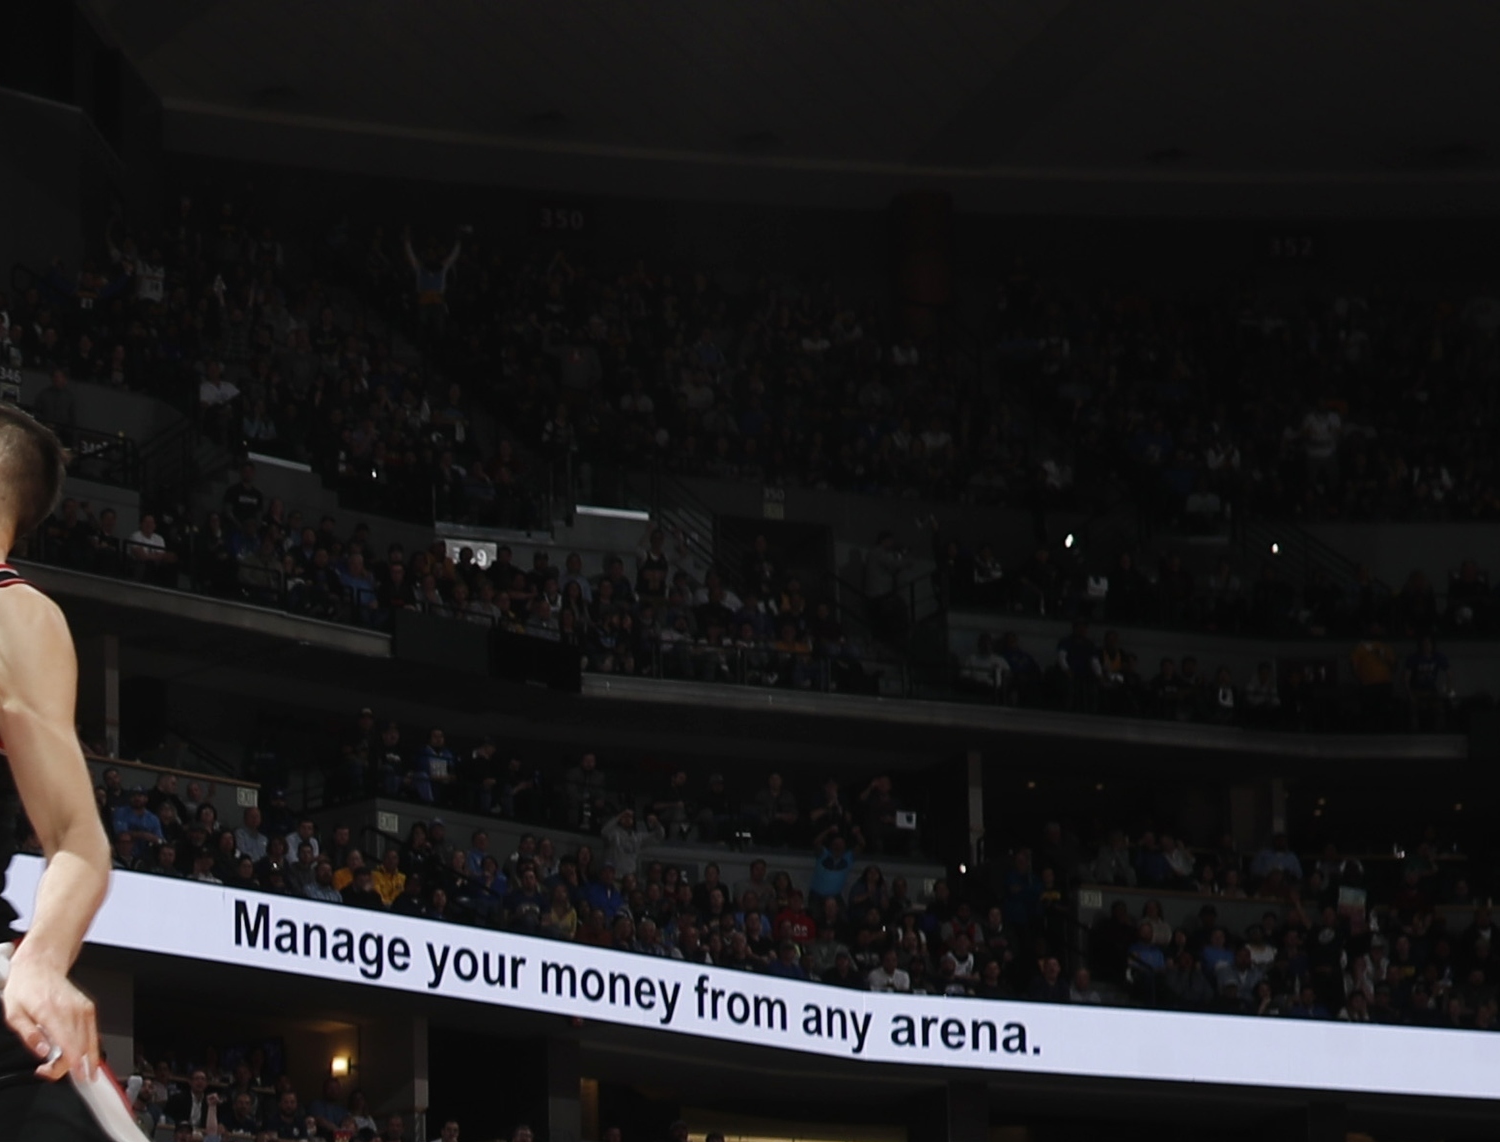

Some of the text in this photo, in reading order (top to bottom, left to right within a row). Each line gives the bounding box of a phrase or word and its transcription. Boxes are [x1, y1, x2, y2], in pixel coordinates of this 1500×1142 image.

[233, 899, 1042, 1056] Manage your money from any arena.
